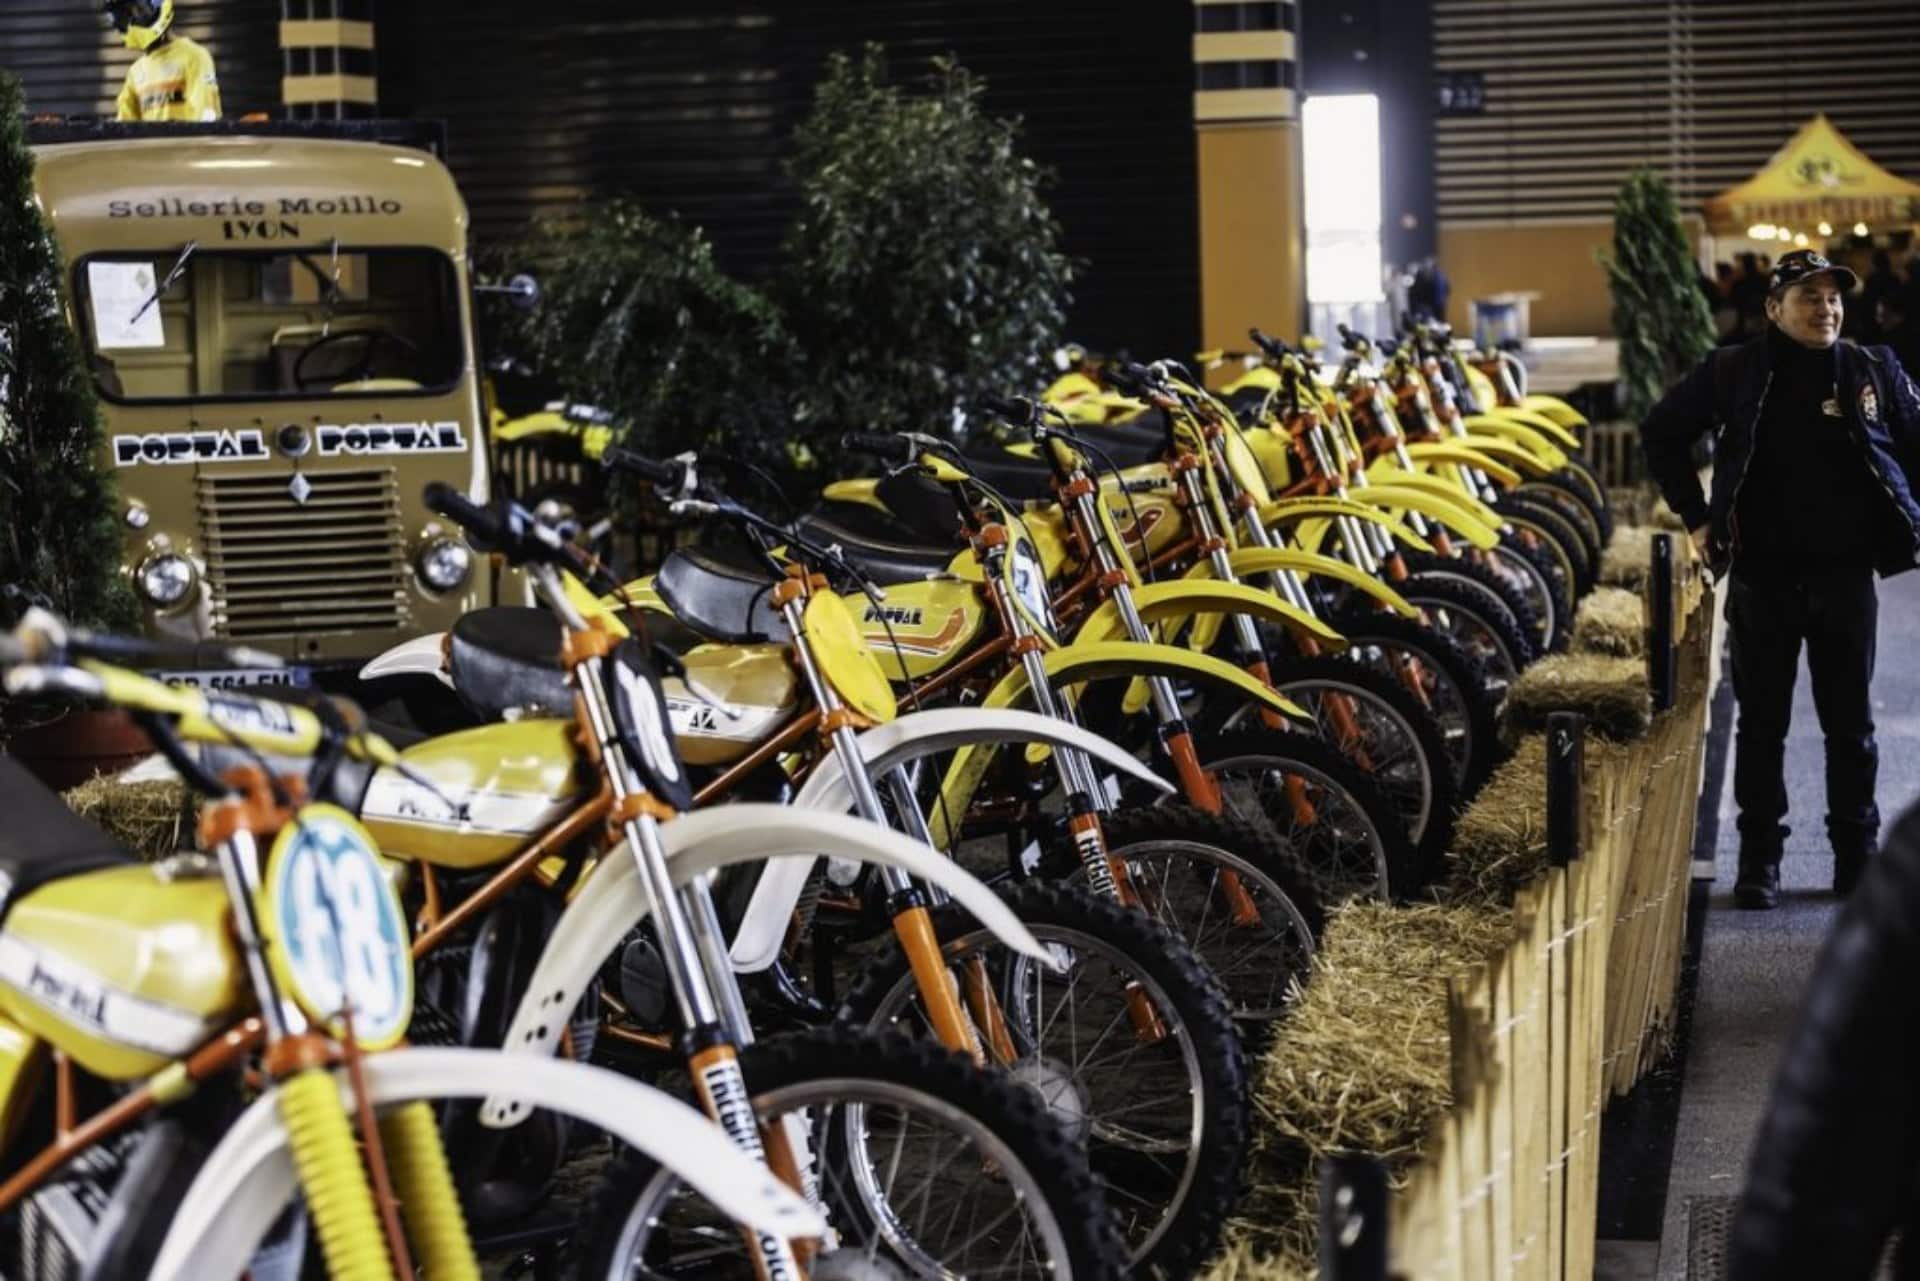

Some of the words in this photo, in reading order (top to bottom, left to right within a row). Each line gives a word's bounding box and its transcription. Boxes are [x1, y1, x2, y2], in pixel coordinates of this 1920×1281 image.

[109, 197, 265, 217] Sellerie
[280, 195, 403, 216] Moillo
[222, 220, 300, 240] LYON
[115, 431, 266, 463] PORTAL
[320, 424, 463, 451] PORTAL
